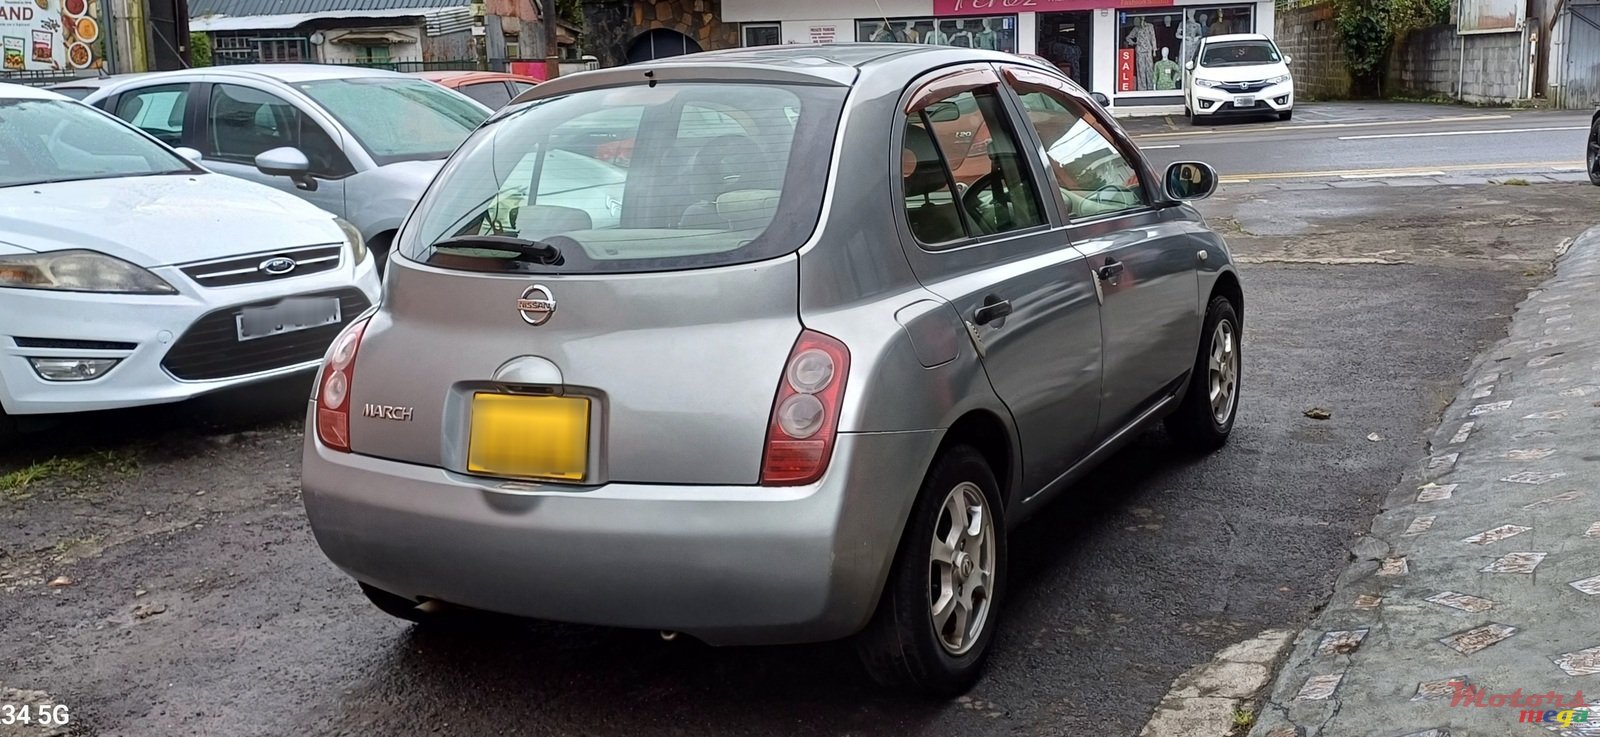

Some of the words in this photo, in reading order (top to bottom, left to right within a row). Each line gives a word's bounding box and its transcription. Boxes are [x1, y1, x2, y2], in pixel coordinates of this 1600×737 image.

[1122, 51, 1130, 91] SALE
[519, 301, 551, 309] NISSAN
[362, 403, 414, 421] MARCH
